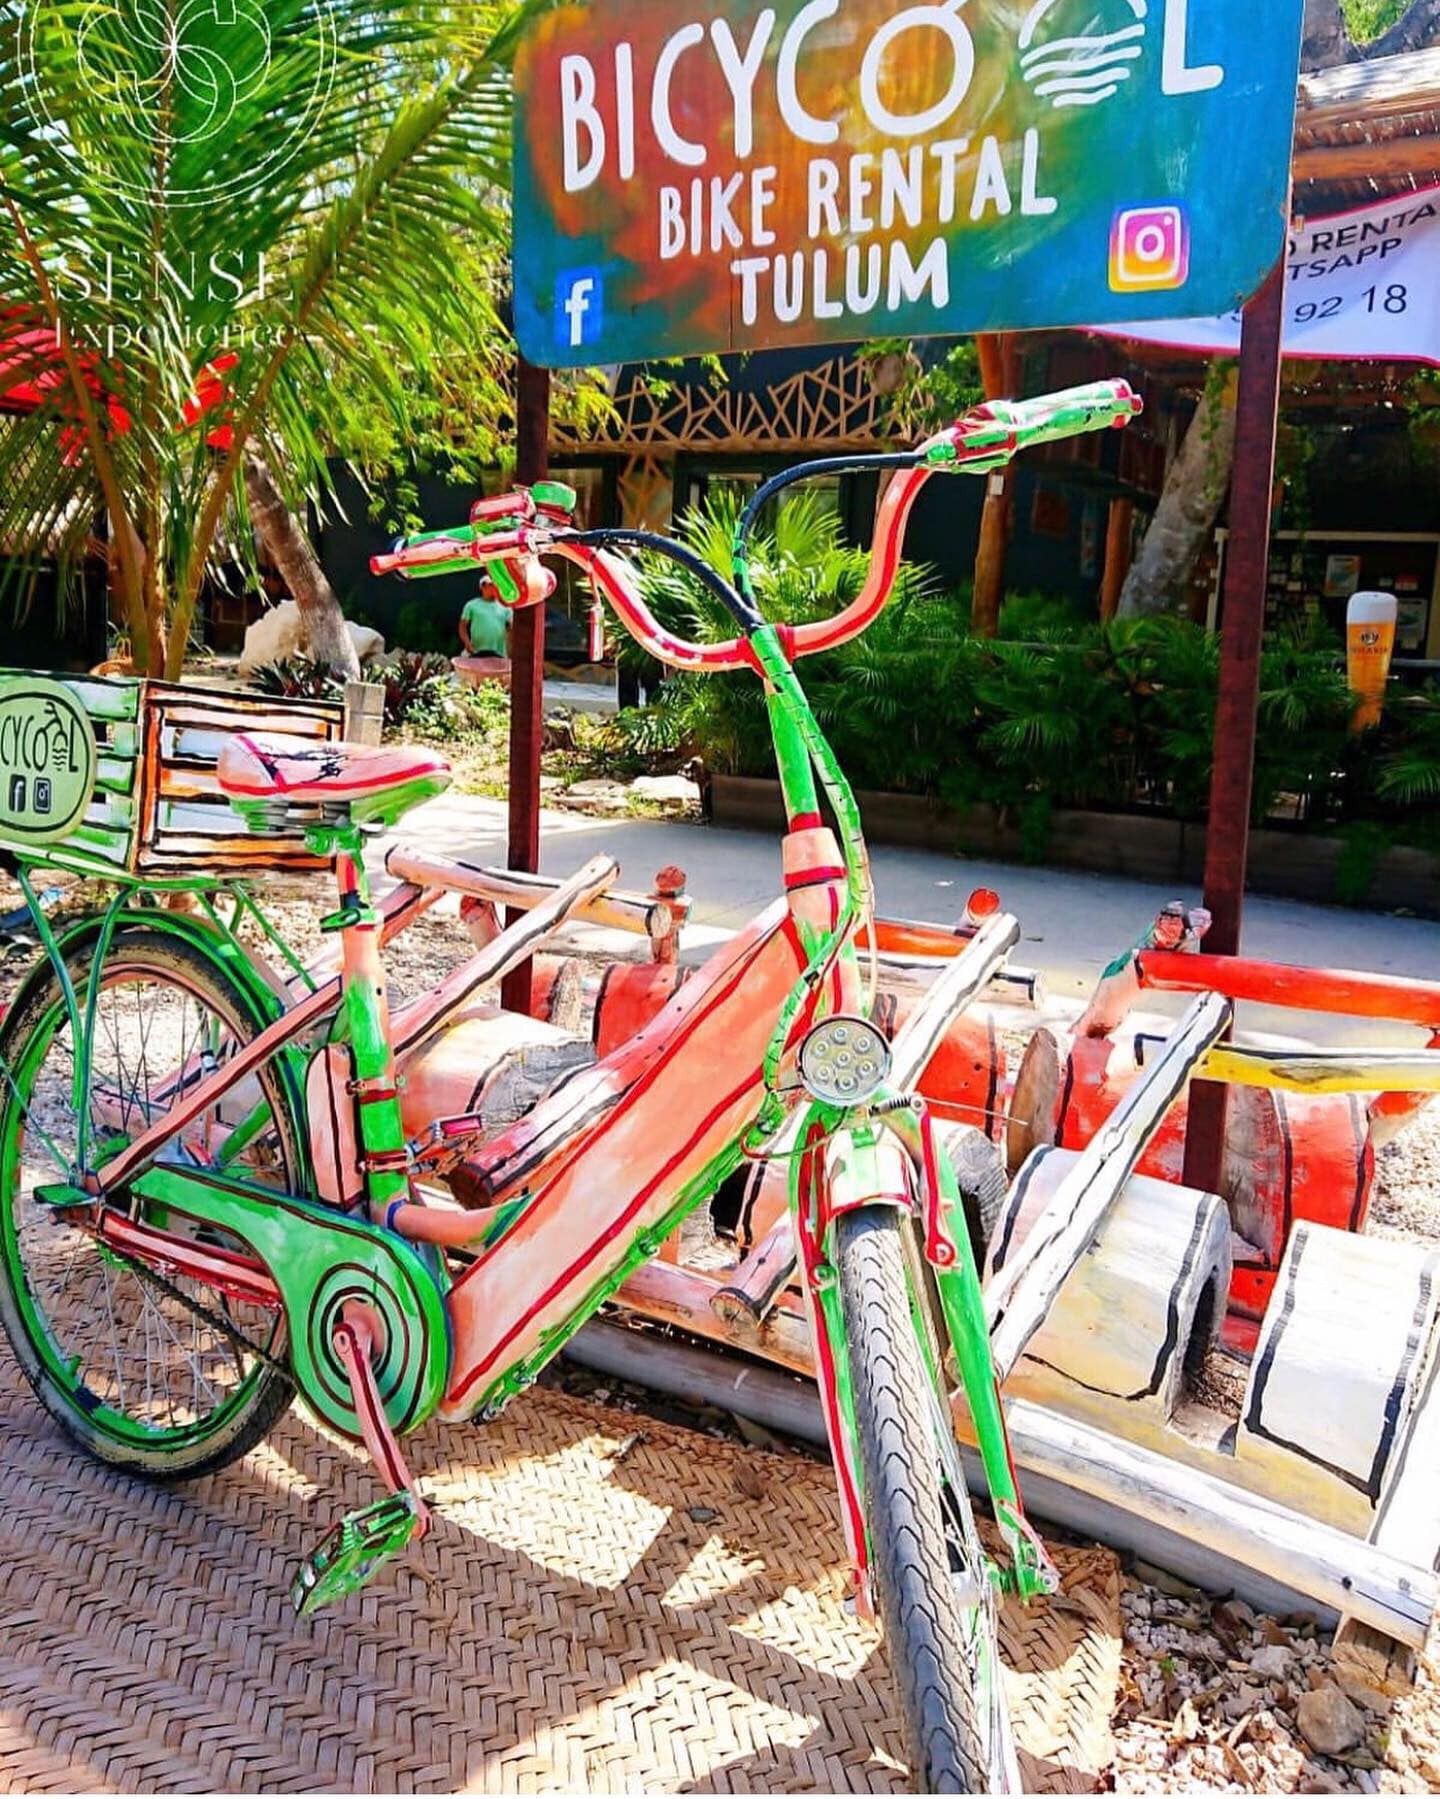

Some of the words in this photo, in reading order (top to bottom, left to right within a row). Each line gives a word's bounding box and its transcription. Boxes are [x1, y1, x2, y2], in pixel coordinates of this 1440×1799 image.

[660, 165, 776, 259] BIKE
[807, 128, 1058, 239] RENTAL
[730, 237, 950, 326] TULUM
[1293, 296, 1343, 323] 92
[1361, 284, 1407, 314] 18
